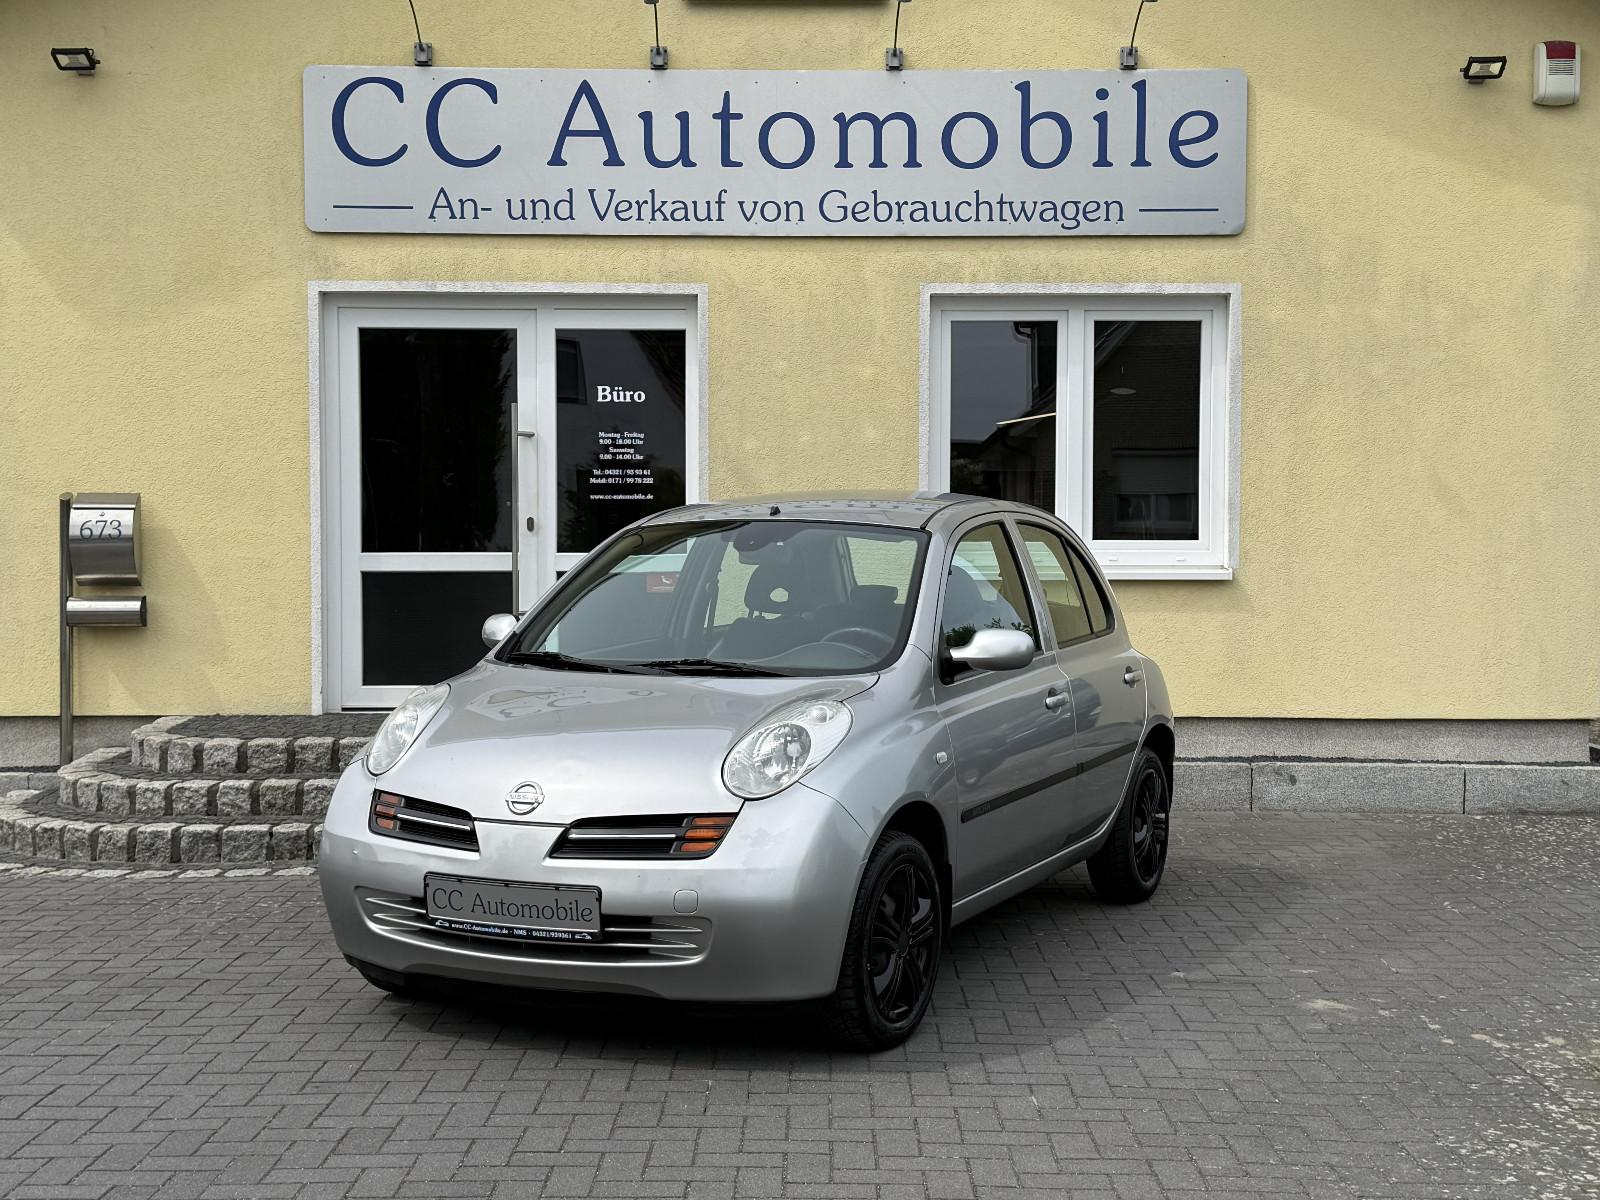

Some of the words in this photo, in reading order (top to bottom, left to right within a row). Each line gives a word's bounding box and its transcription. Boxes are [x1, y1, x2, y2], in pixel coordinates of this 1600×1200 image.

[331, 77, 502, 168] CC
[546, 79, 1219, 169] Automobile
[428, 187, 493, 220] An-
[506, 188, 575, 221] und
[588, 188, 727, 222] Verkauf
[738, 200, 805, 222] von
[818, 189, 1125, 230] Gebrauchtwagen
[597, 386, 645, 402] Büro
[80, 519, 122, 541] 673
[509, 793, 540, 801] NISSAN
[432, 887, 463, 911] CC
[471, 892, 593, 922] Automobile
[513, 928, 527, 936] NMS
